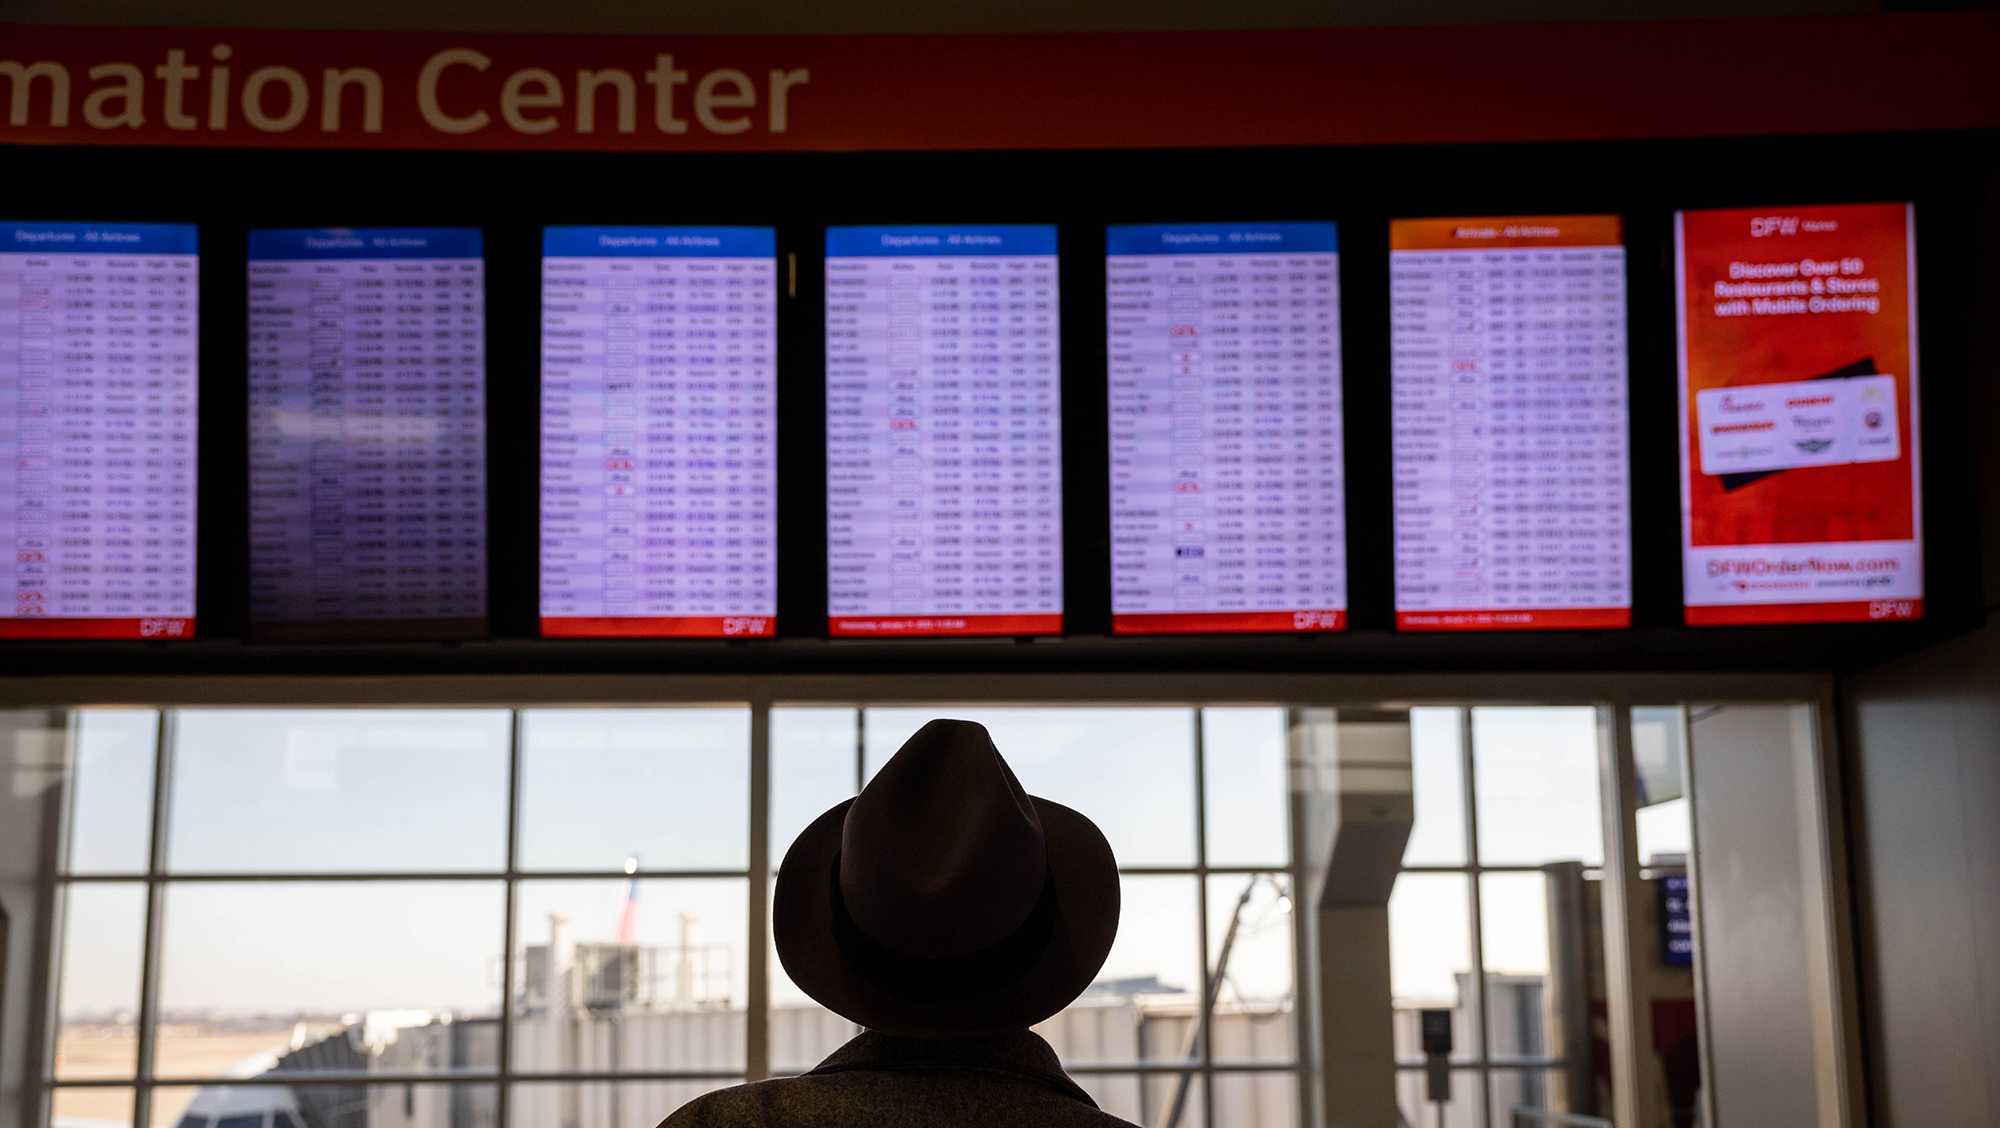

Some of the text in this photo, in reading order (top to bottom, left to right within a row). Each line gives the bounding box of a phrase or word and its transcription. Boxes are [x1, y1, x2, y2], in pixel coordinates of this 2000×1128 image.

[0, 44, 809, 135] mation Center
[1751, 217, 1799, 237] DFW
[1729, 261, 1798, 279] Discover
[1714, 295, 1880, 316] with Mobile Ordering
